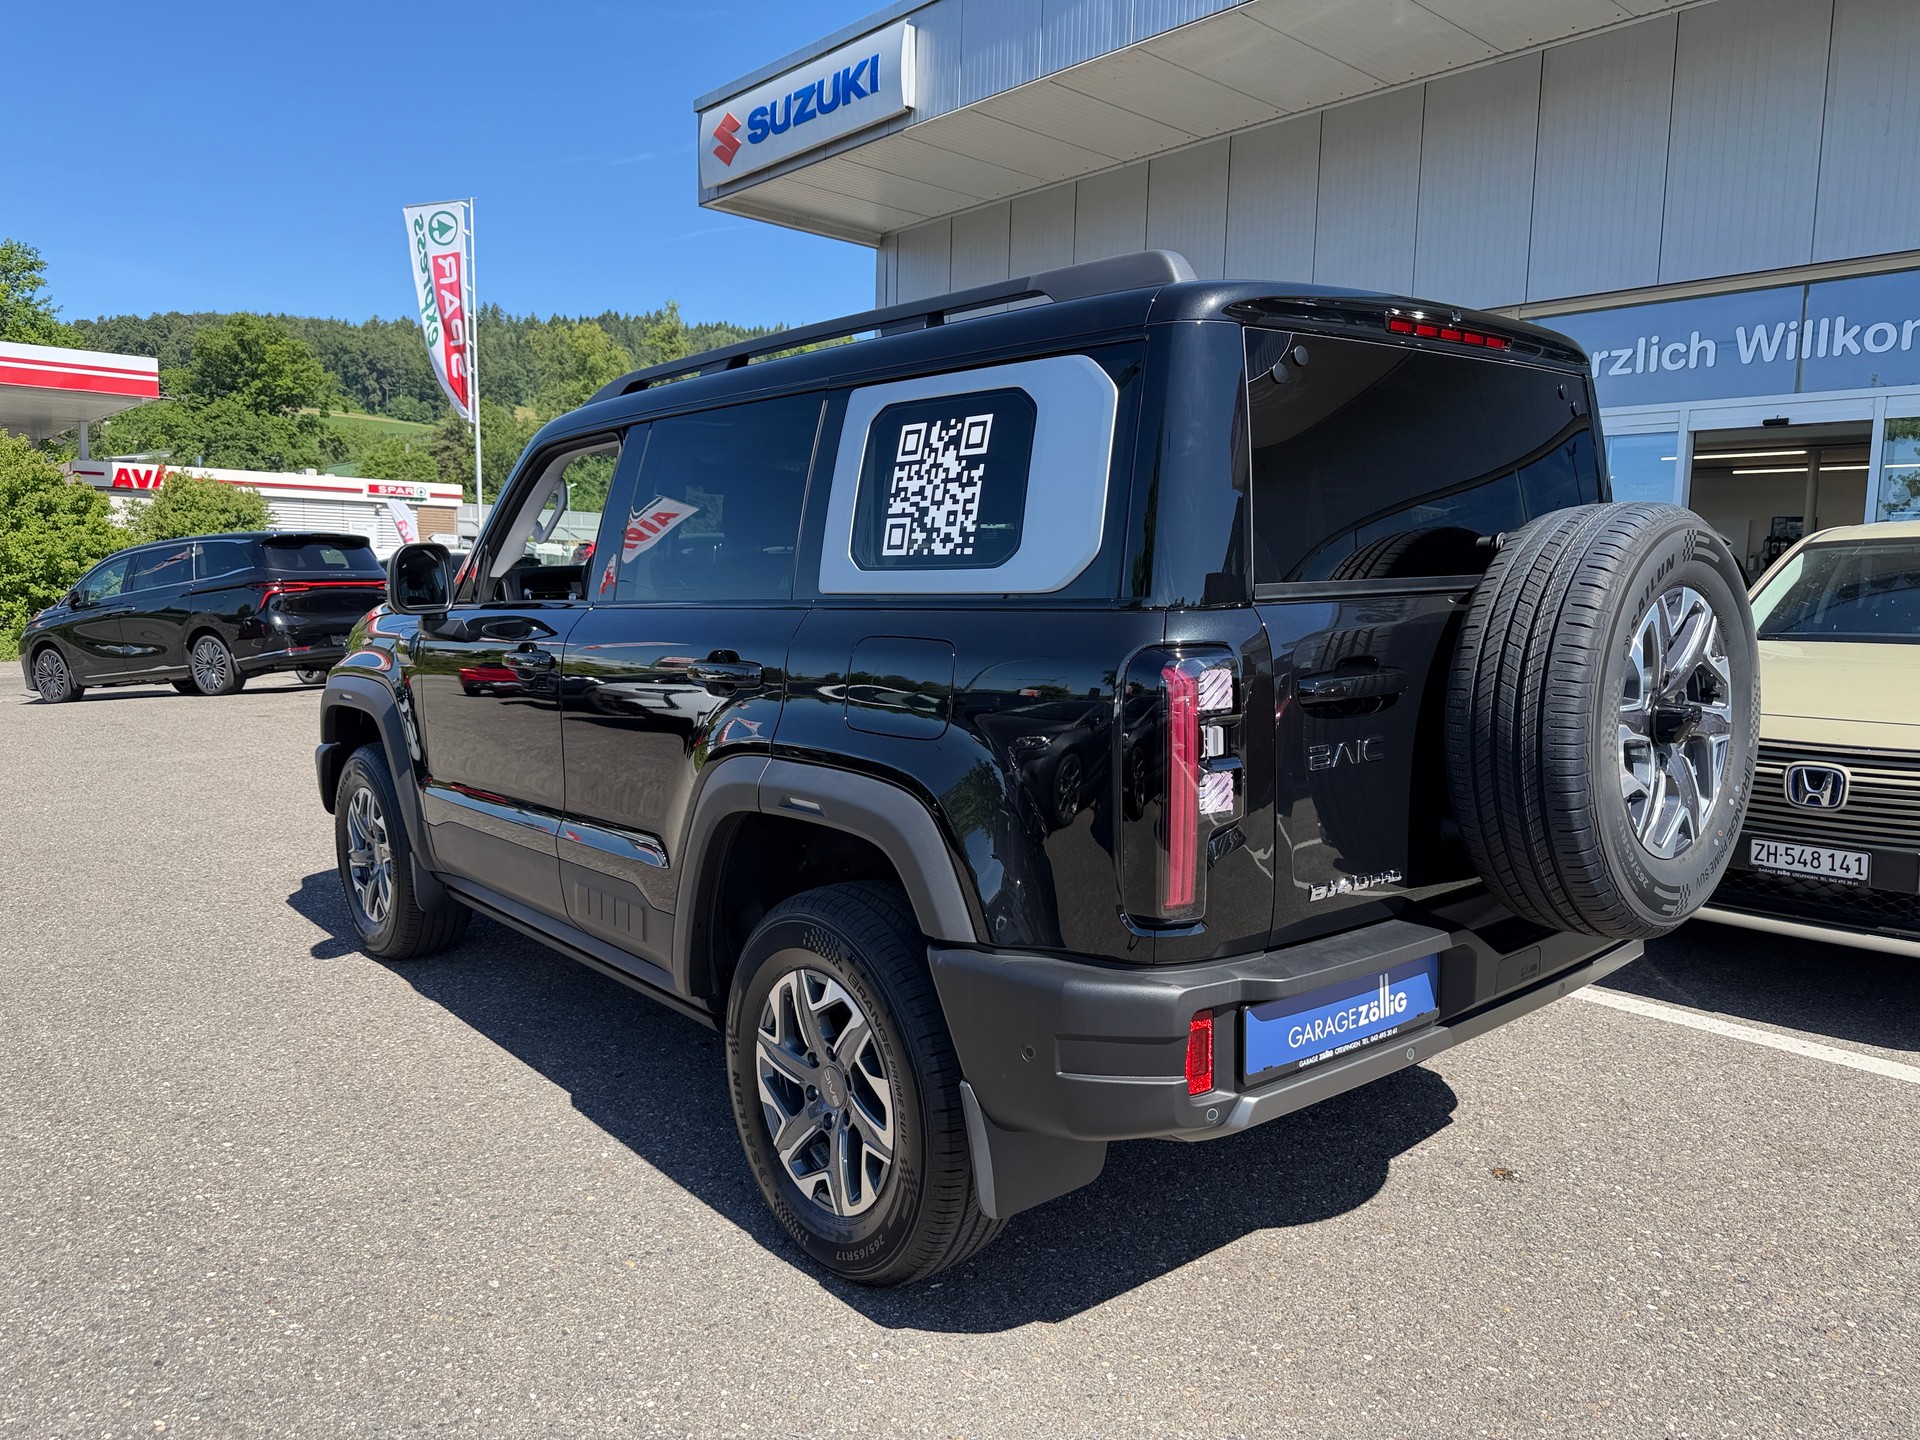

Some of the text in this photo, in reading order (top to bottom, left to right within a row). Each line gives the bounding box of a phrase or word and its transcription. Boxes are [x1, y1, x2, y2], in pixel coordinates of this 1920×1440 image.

[747, 53, 881, 145] SUZUKI
[1591, 330, 1717, 379] rzlich
[378, 485, 414, 495] SPAR
[1631, 554, 1675, 631] SAILUN
[1308, 735, 1385, 772] BAIC
[1827, 853, 1864, 876] 141
[1299, 1055, 1319, 1067] GARAGE
[732, 1070, 761, 1166] SAILUN
[835, 1233, 886, 1261] 265/65R17
